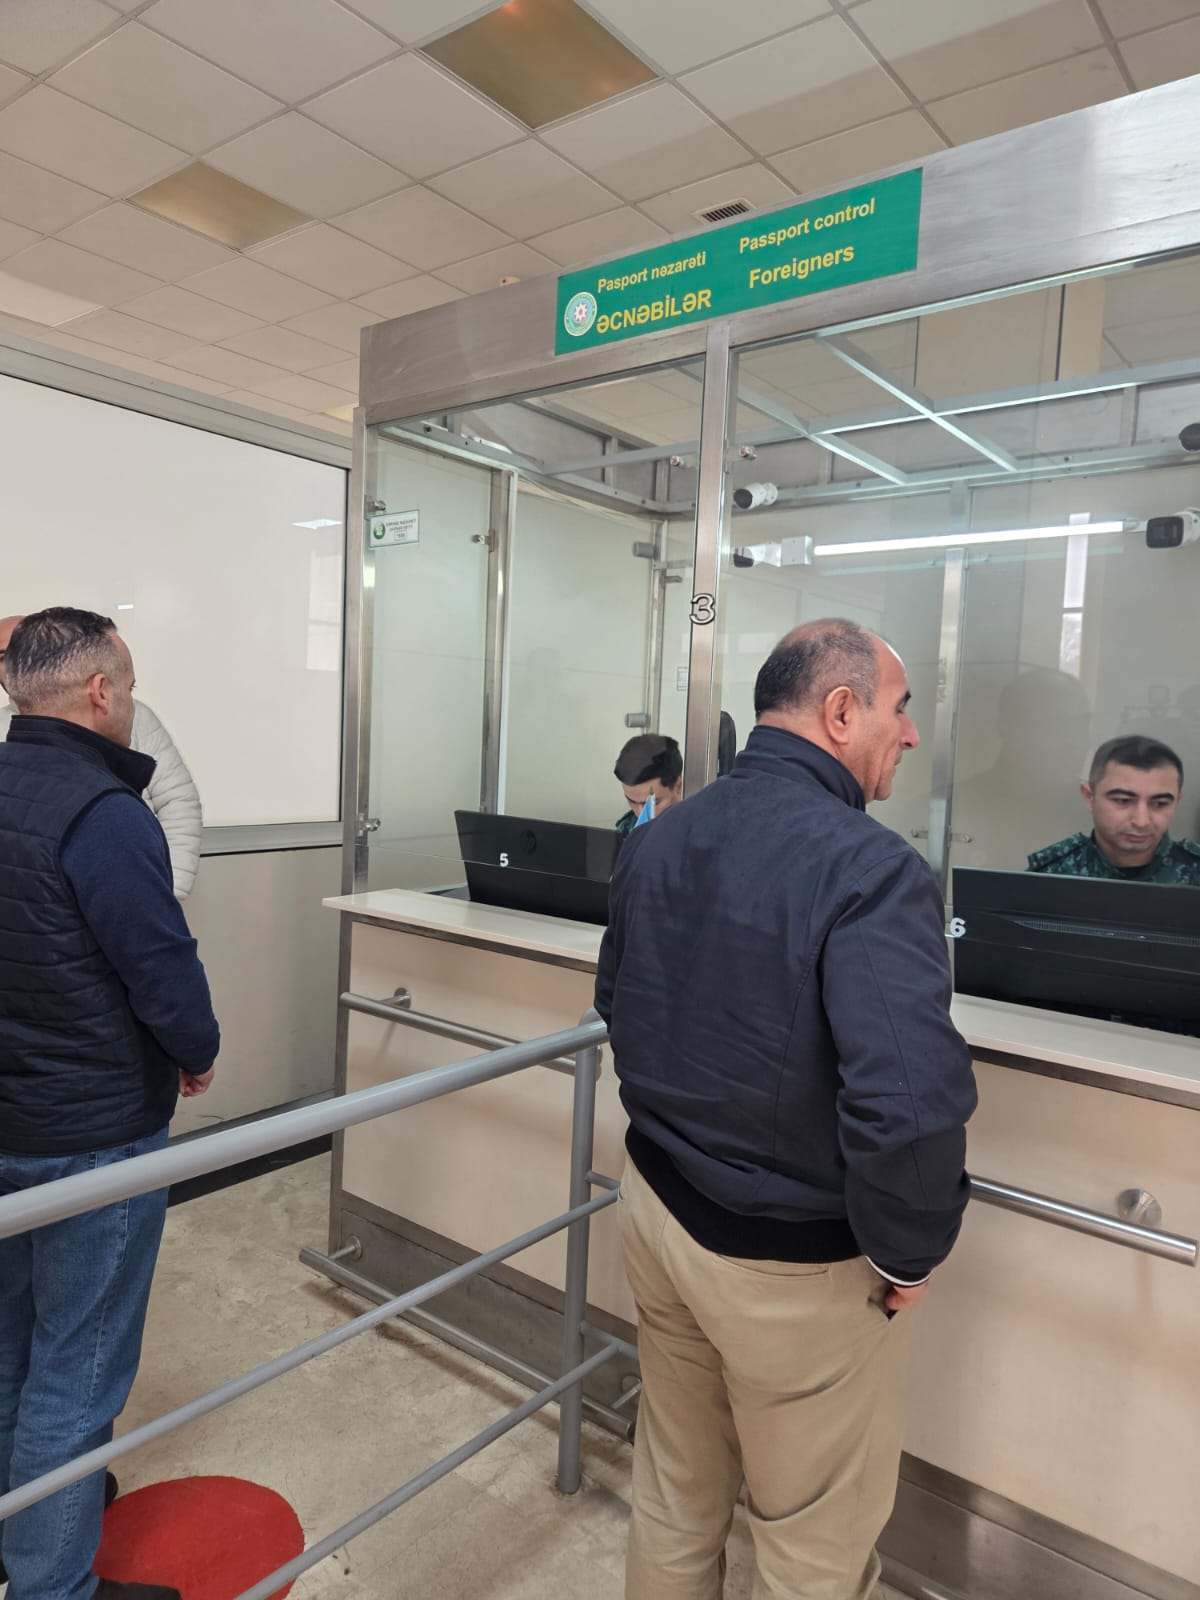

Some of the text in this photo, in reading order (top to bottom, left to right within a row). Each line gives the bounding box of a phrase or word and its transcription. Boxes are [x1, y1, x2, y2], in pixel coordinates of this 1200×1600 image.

[739, 198, 876, 253] Passport control
[597, 252, 707, 293] Pasport nəzarəti
[748, 246, 856, 289] Foreigners
[596, 289, 713, 334] ƏCNƏBİLƏR
[689, 592, 716, 626] 3
[499, 852, 509, 868] 5
[949, 916, 967, 938] 6
